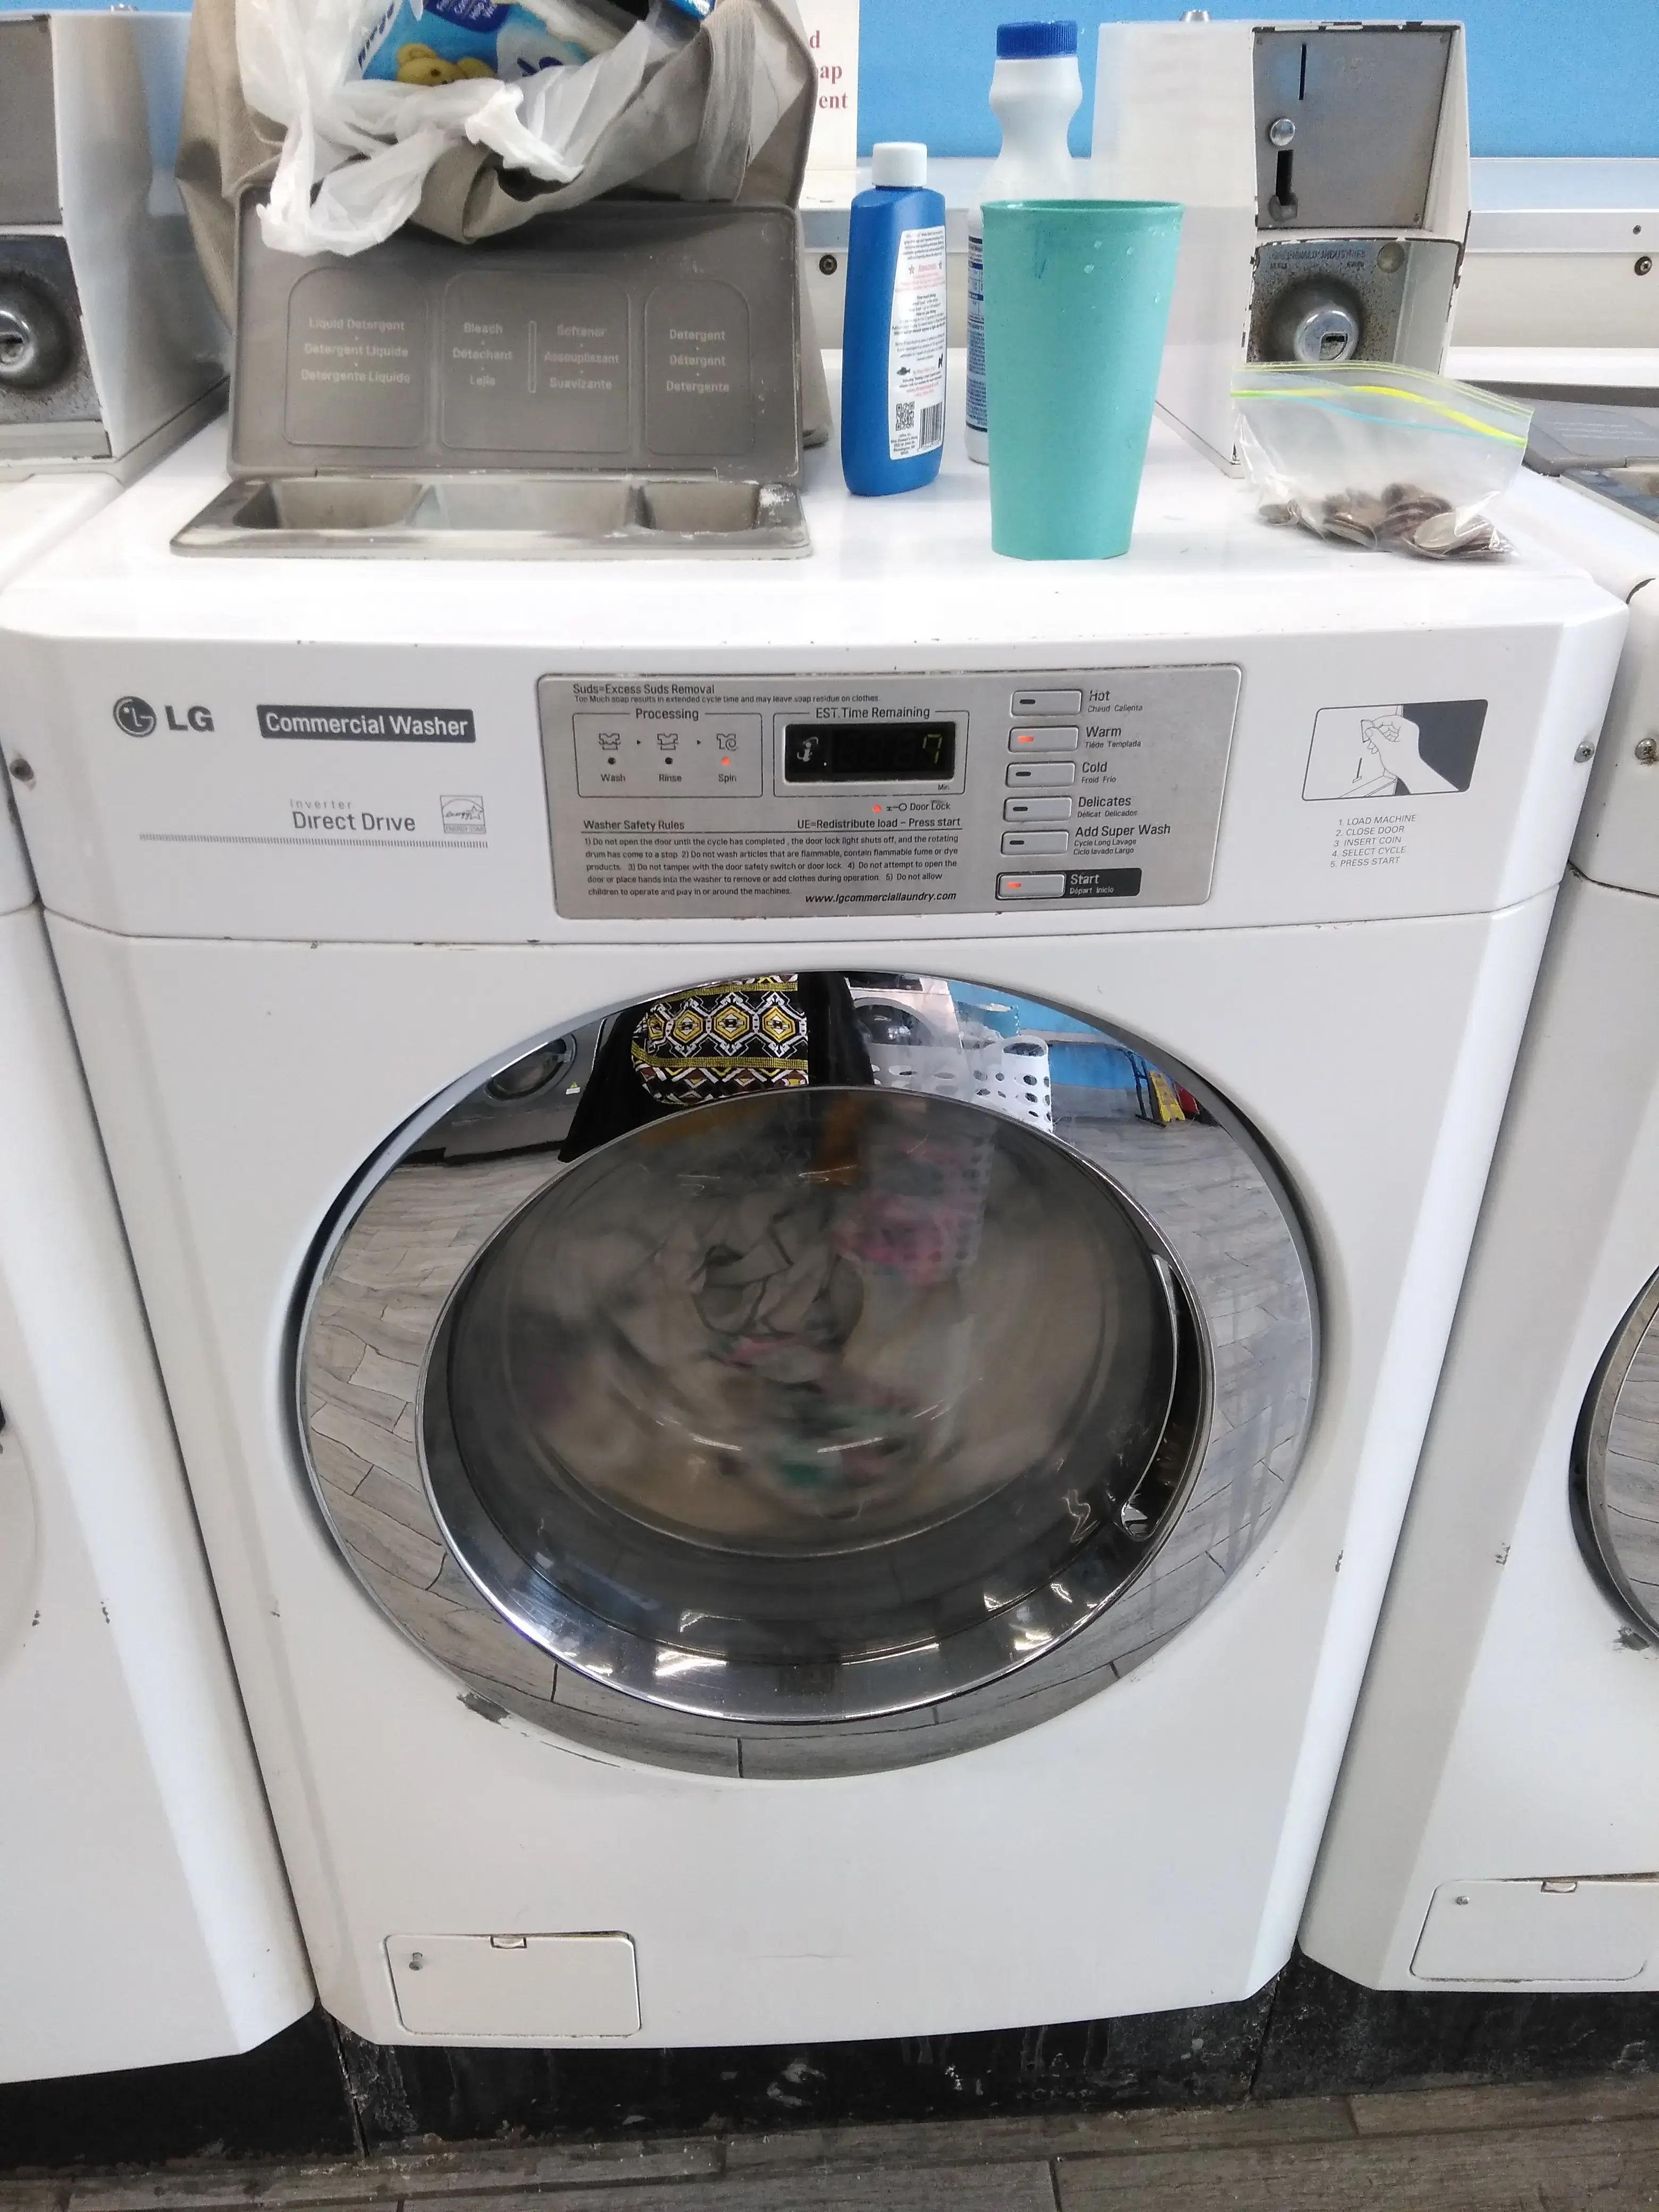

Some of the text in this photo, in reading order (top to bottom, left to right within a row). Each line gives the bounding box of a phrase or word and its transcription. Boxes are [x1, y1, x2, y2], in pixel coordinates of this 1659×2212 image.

[817, 65, 842, 85] ap
[819, 93, 848, 108] ent
[573, 684, 714, 693] Suds=Excess Suds Removal
[1089, 690, 1110, 701] Hot
[636, 708, 698, 720] Processing
[872, 707, 929, 718] Remaining
[164, 706, 214, 731] LG
[266, 714, 467, 734] Commercial Washer
[1086, 726, 1121, 736] Warm
[922, 734, 942, 764] 7
[1083, 761, 1107, 772] Cold
[719, 774, 736, 783] Spin
[290, 800, 351, 809] Inverter
[1079, 797, 1131, 807] Delicates
[292, 811, 415, 831] Direct Drive
[624, 820, 655, 831] Safety
[798, 819, 875, 828] UE=Redistribute
[1075, 824, 1170, 837] Add Super Wash
[1071, 873, 1099, 884] Start
[806, 893, 956, 903] www.lgcommerciallaundry.com
